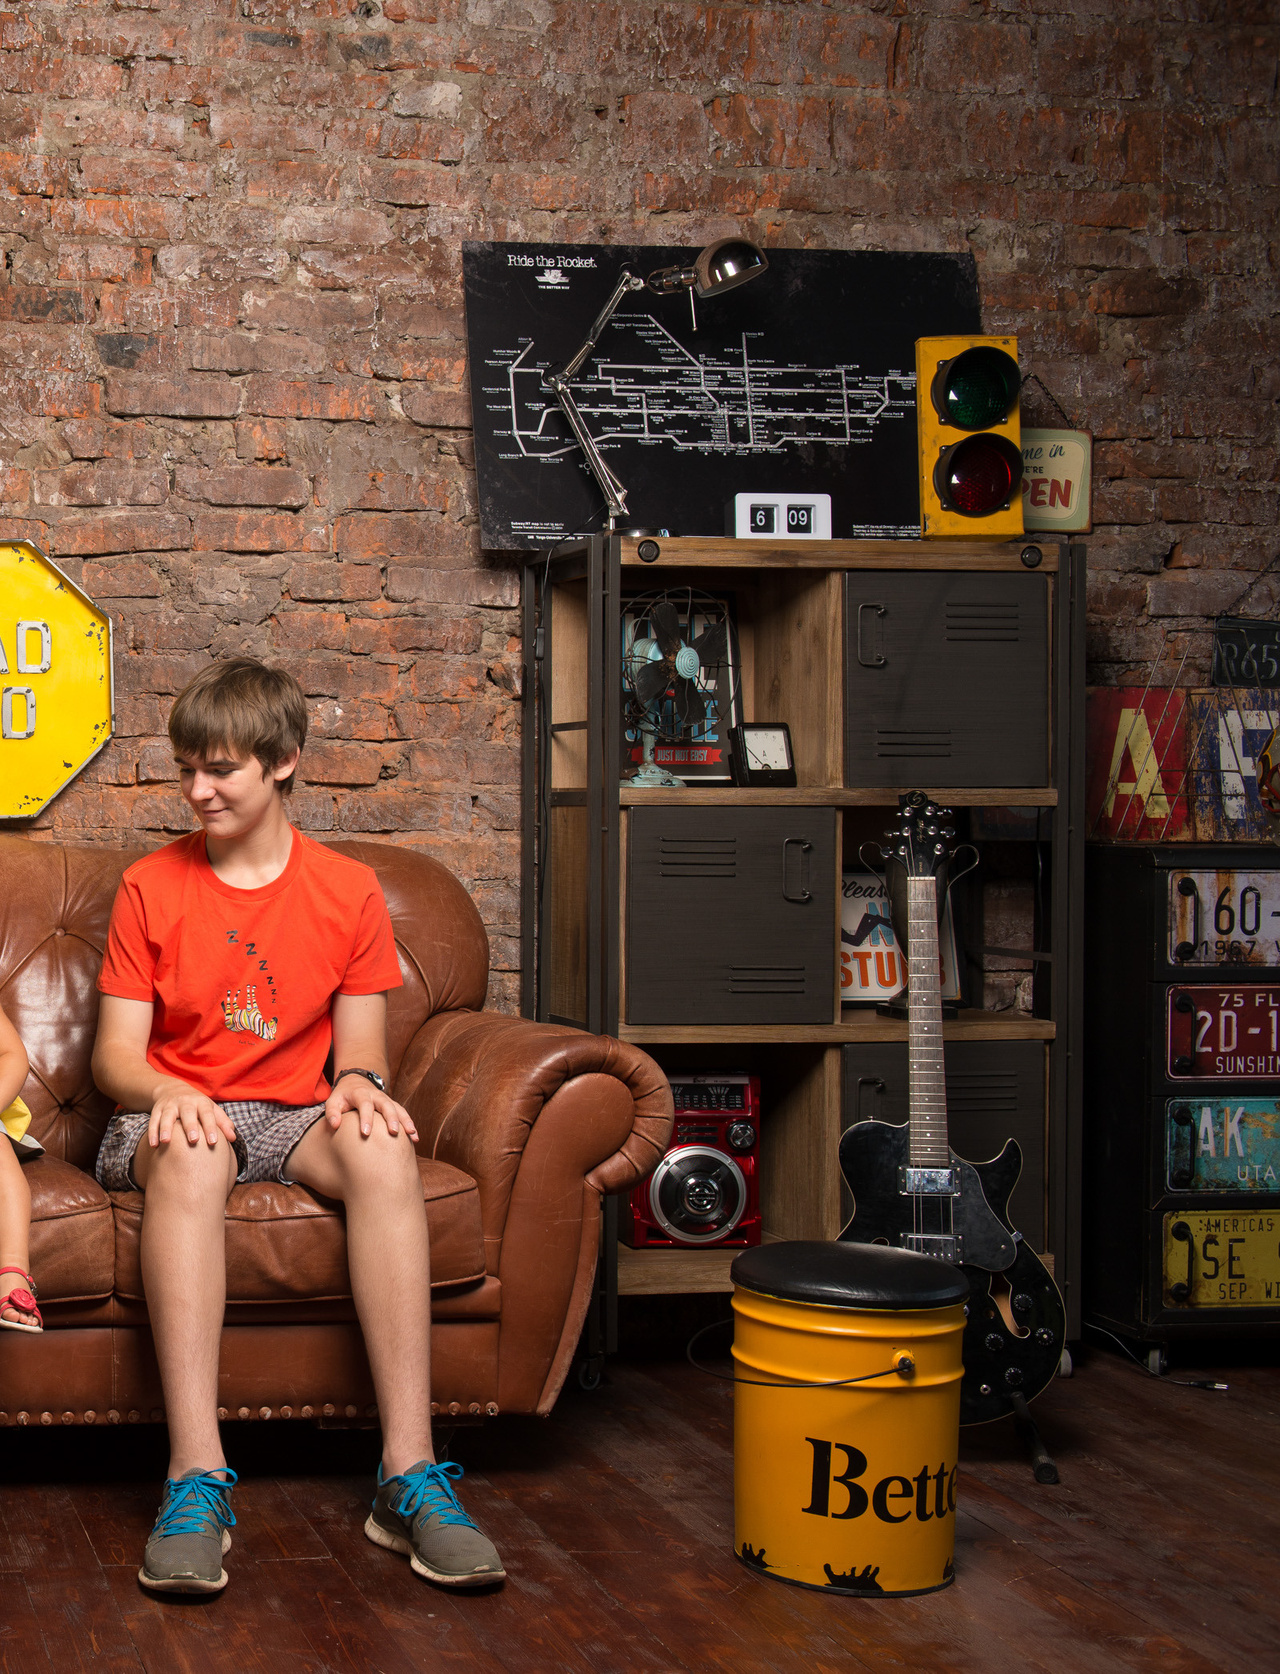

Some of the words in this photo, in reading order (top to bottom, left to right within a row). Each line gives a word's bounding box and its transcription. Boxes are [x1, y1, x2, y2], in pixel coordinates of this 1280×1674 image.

[507, 254, 535, 267] Ride
[536, 255, 555, 267] the
[556, 256, 597, 268] Rocket.
[1049, 444, 1065, 458] in
[789, 510, 808, 526] 09
[656, 749, 674, 762] JUST
[675, 749, 689, 762] NOT
[689, 749, 708, 762] EASY
[1219, 993, 1245, 1007] 75
[1196, 1106, 1245, 1158] AK
[1206, 1218, 1273, 1233] AMERICAS
[1202, 1238, 1245, 1279] SE
